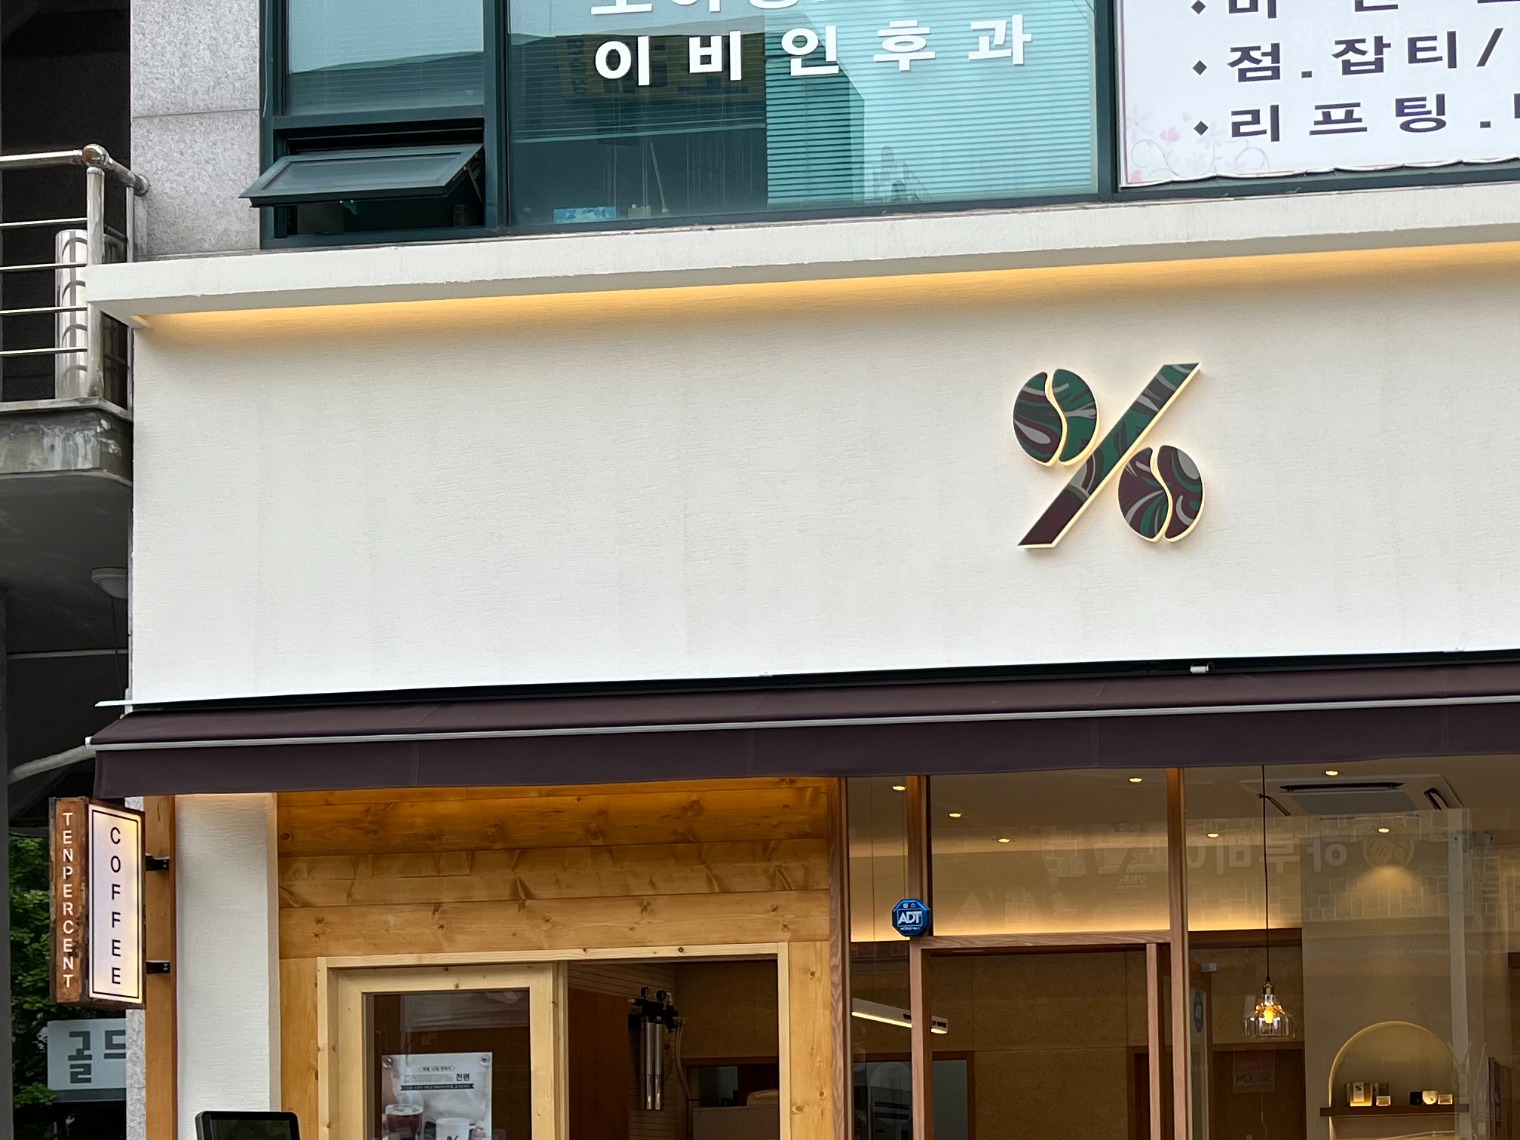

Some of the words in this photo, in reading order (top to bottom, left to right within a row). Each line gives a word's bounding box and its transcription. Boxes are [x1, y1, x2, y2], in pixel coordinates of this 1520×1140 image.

[594, 14, 1032, 86] 이비인후과
[61, 811, 74, 989] TENPERCENT
[109, 826, 122, 985] COFFEE
[897, 911, 922, 924] ADT
